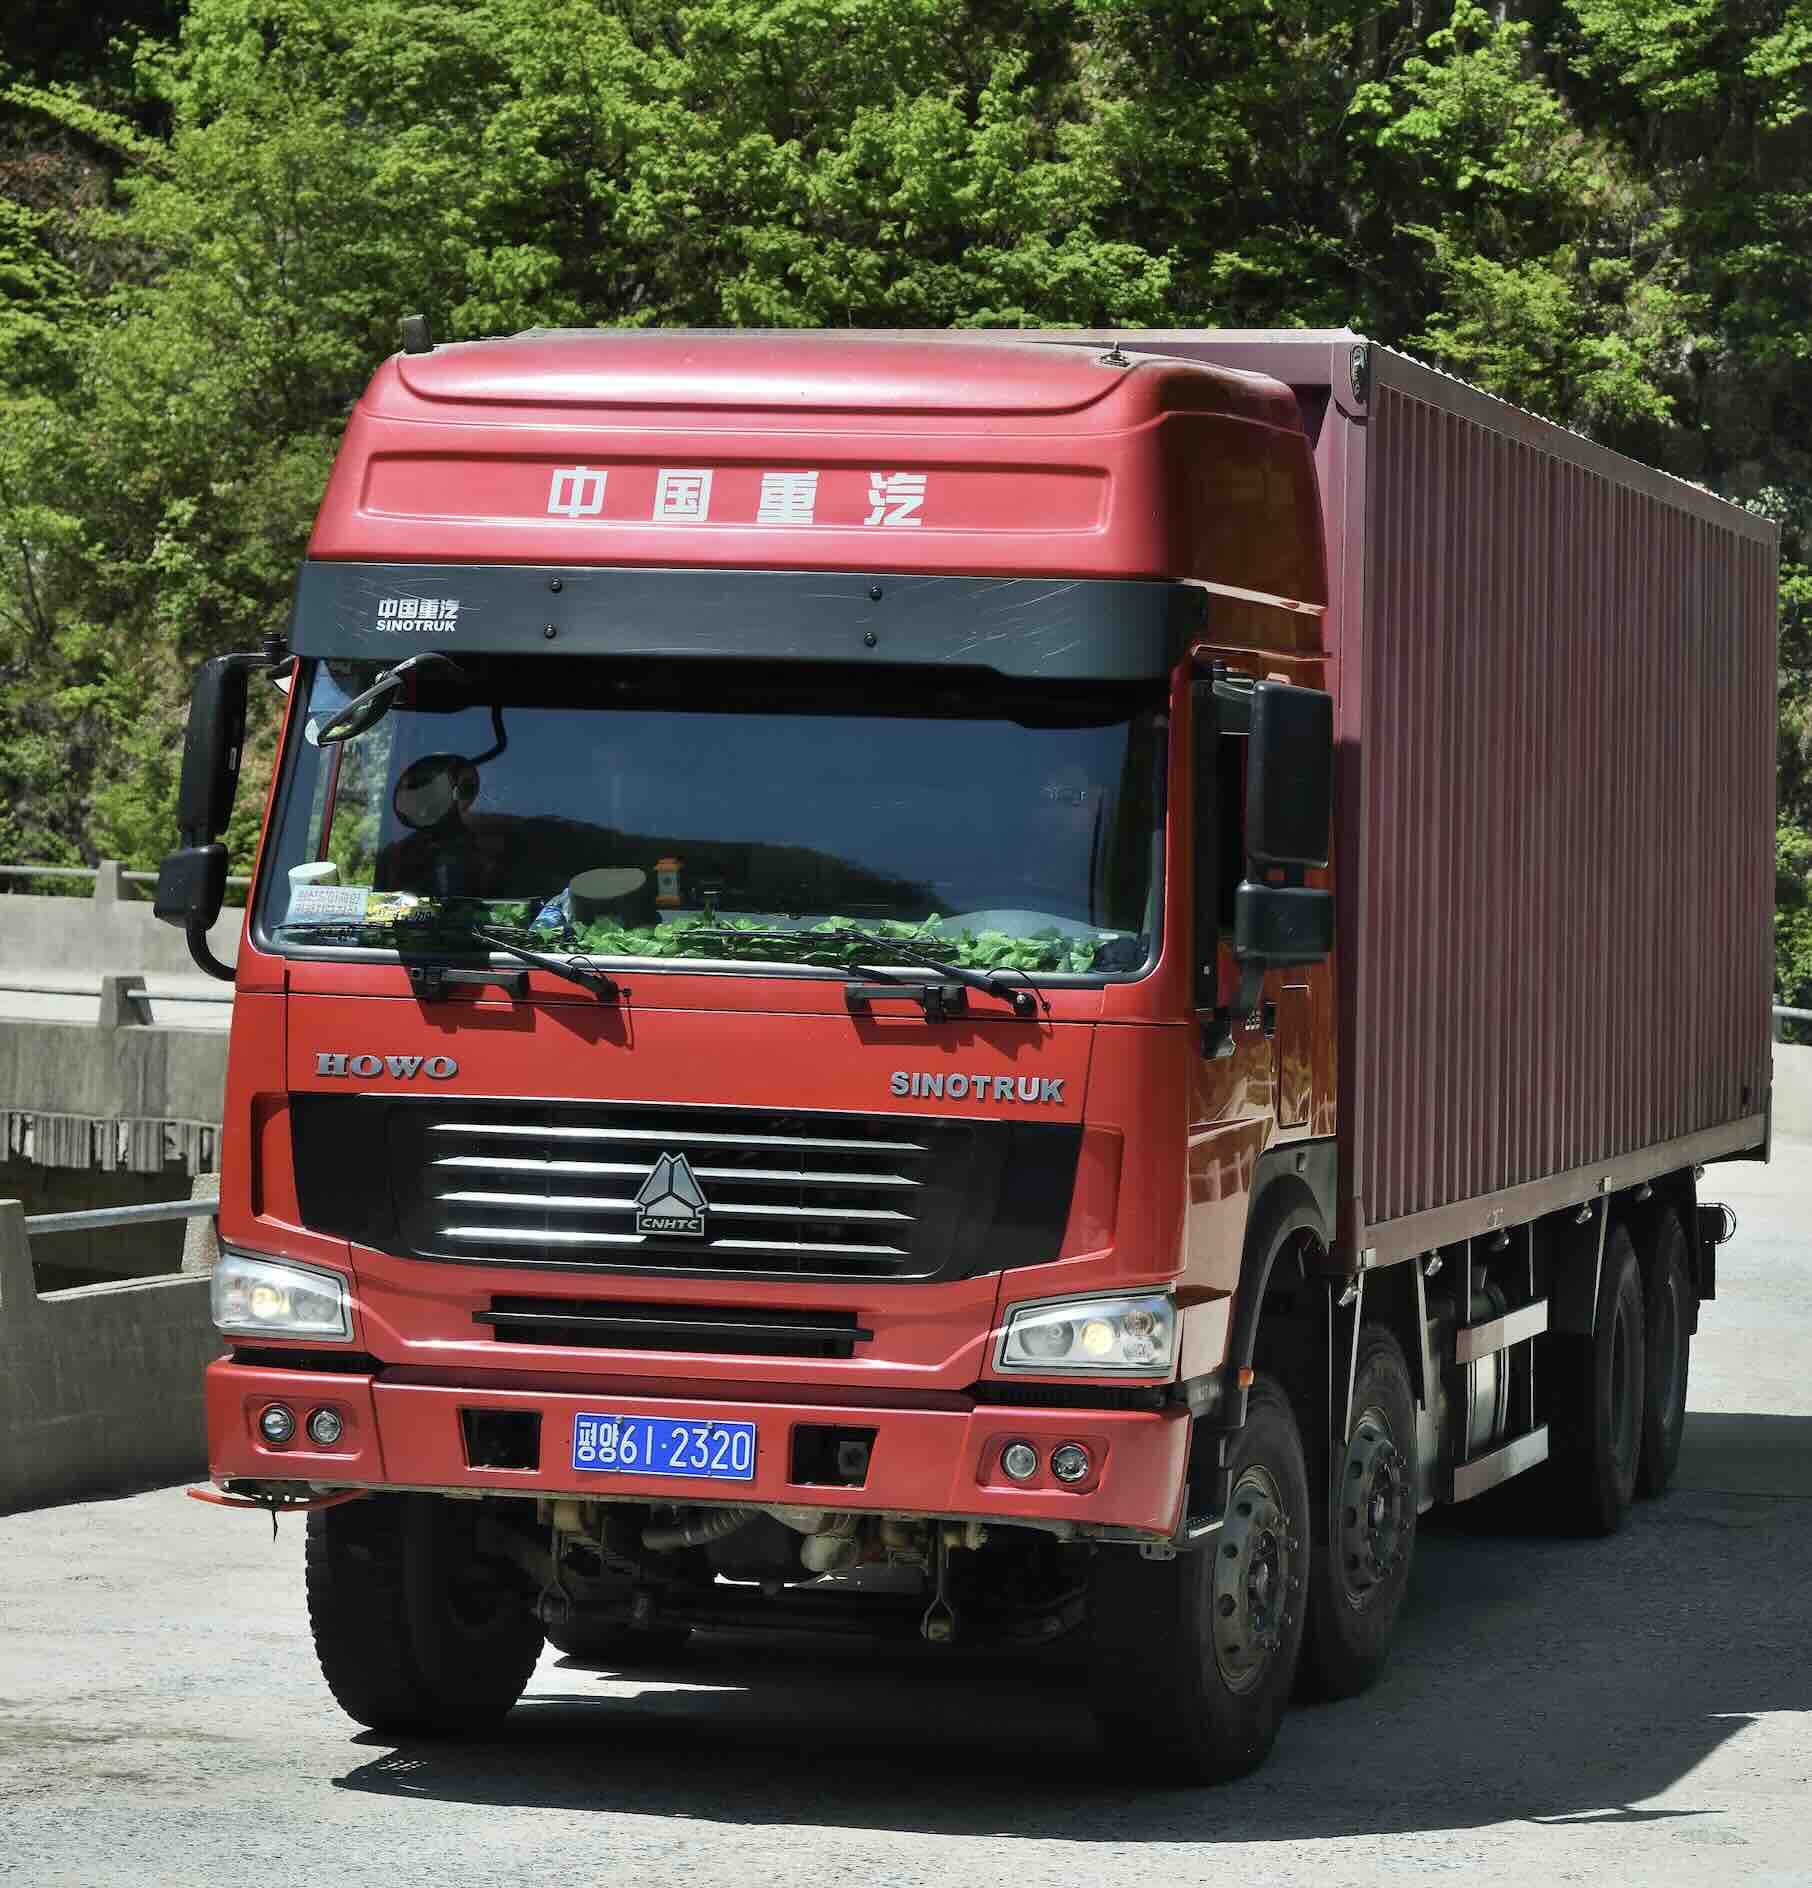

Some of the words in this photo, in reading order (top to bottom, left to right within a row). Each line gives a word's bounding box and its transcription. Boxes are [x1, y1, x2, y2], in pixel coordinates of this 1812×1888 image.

[547, 466, 928, 526] 中国重汽
[377, 598, 459, 619] 中国重汽
[376, 620, 456, 632] SINOTRUK
[315, 1053, 458, 1078] HOWO
[891, 1072, 1065, 1102] SINOTRUK
[640, 1218, 698, 1230] CNHTC
